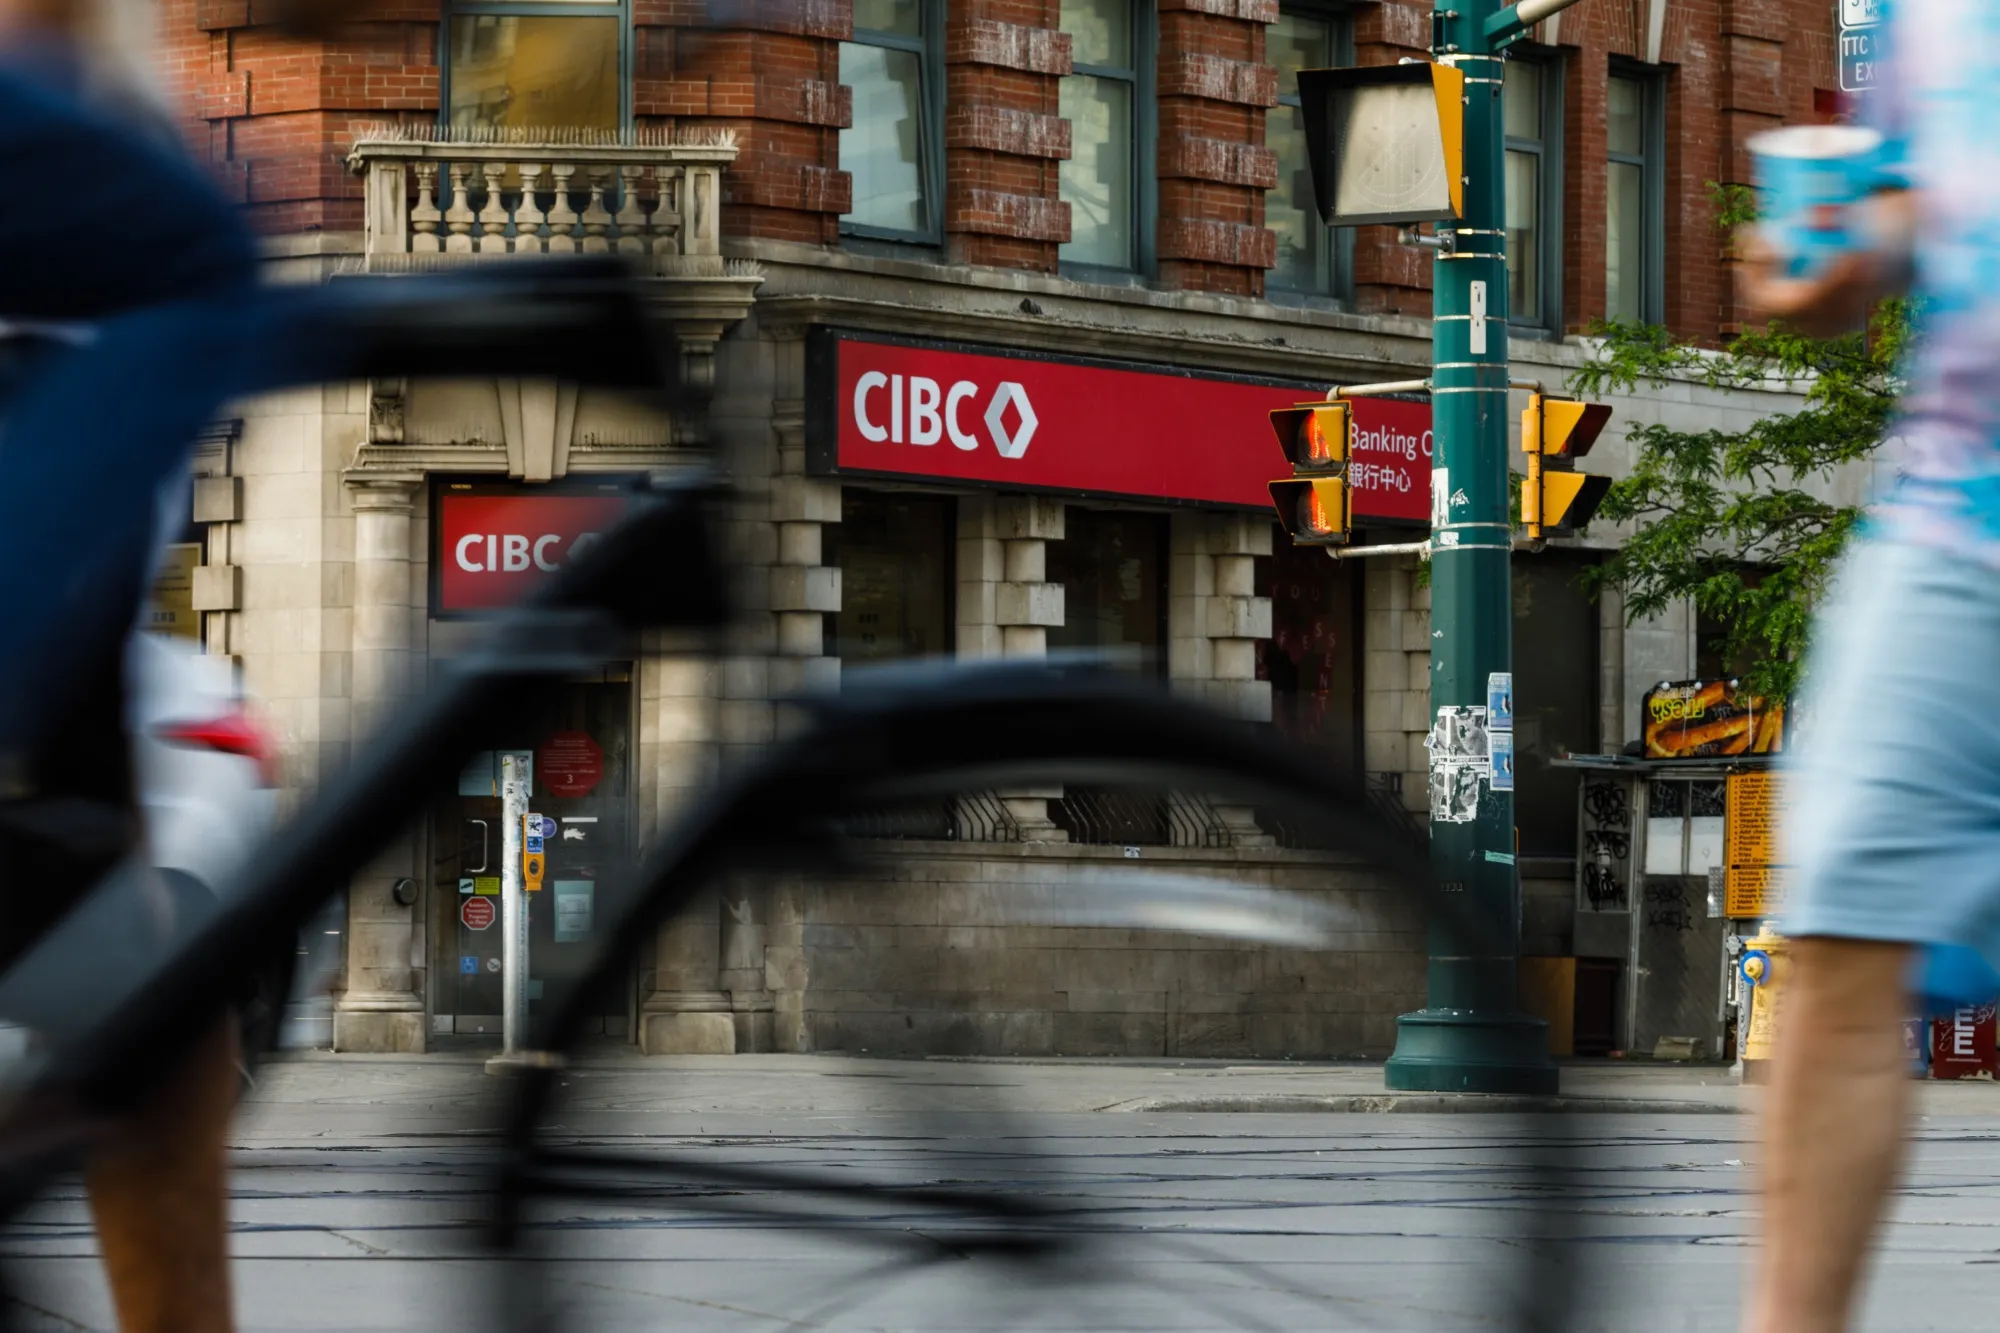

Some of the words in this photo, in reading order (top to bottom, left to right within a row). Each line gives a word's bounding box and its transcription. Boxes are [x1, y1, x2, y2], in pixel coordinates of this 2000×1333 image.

[1864, 7, 1879, 17] MO
[1842, 35, 1868, 57] TTC
[853, 370, 979, 451] CIBC
[1351, 422, 1418, 461] Banking
[455, 532, 562, 573] CIBC
[1953, 1007, 1976, 1055] EE
